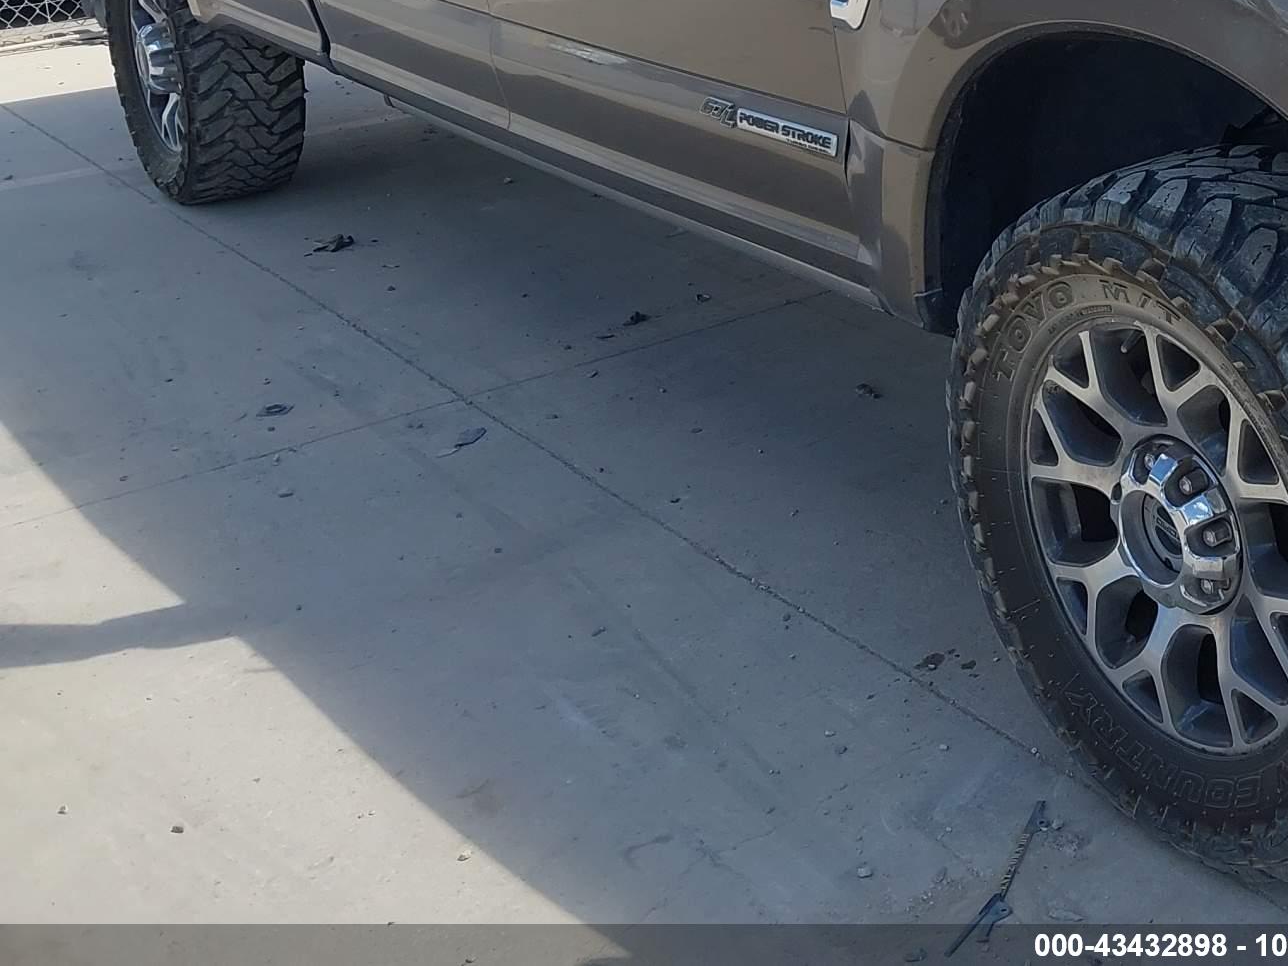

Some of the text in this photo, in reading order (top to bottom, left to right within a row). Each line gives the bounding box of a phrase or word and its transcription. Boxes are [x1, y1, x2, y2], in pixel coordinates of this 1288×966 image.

[739, 112, 780, 134] POWER
[782, 125, 832, 149] STROKE
[992, 280, 1075, 382] TOYO
